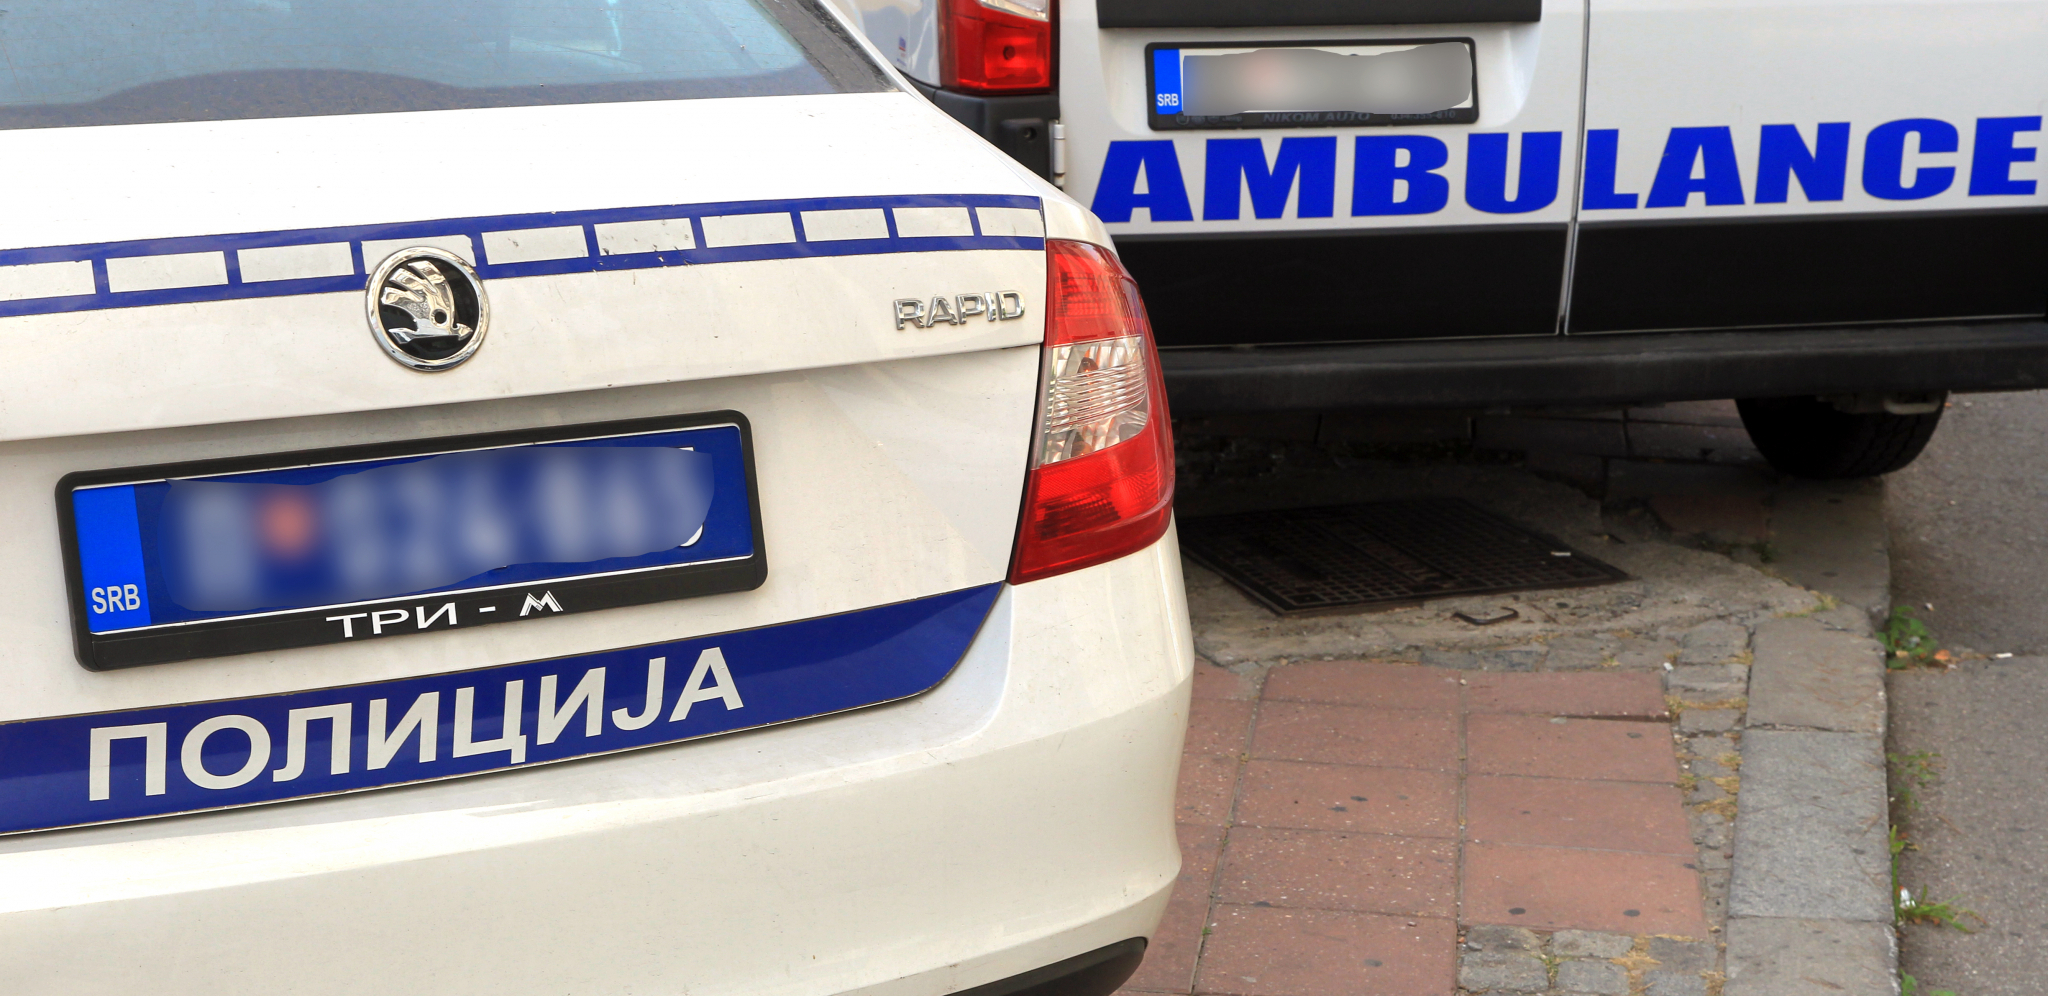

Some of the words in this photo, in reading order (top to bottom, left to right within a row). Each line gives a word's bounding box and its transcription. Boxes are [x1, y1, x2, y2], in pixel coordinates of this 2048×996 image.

[1157, 93, 1179, 107] SRB
[1263, 112, 1319, 123] NIKOM
[1325, 111, 1371, 122] AUTO
[1090, 116, 2043, 223] AMBULANCE
[893, 290, 1026, 331] RAPID
[92, 584, 141, 615] SRB
[326, 602, 458, 638] ТРИ
[89, 647, 744, 801] ПОЛИЦИЈА
